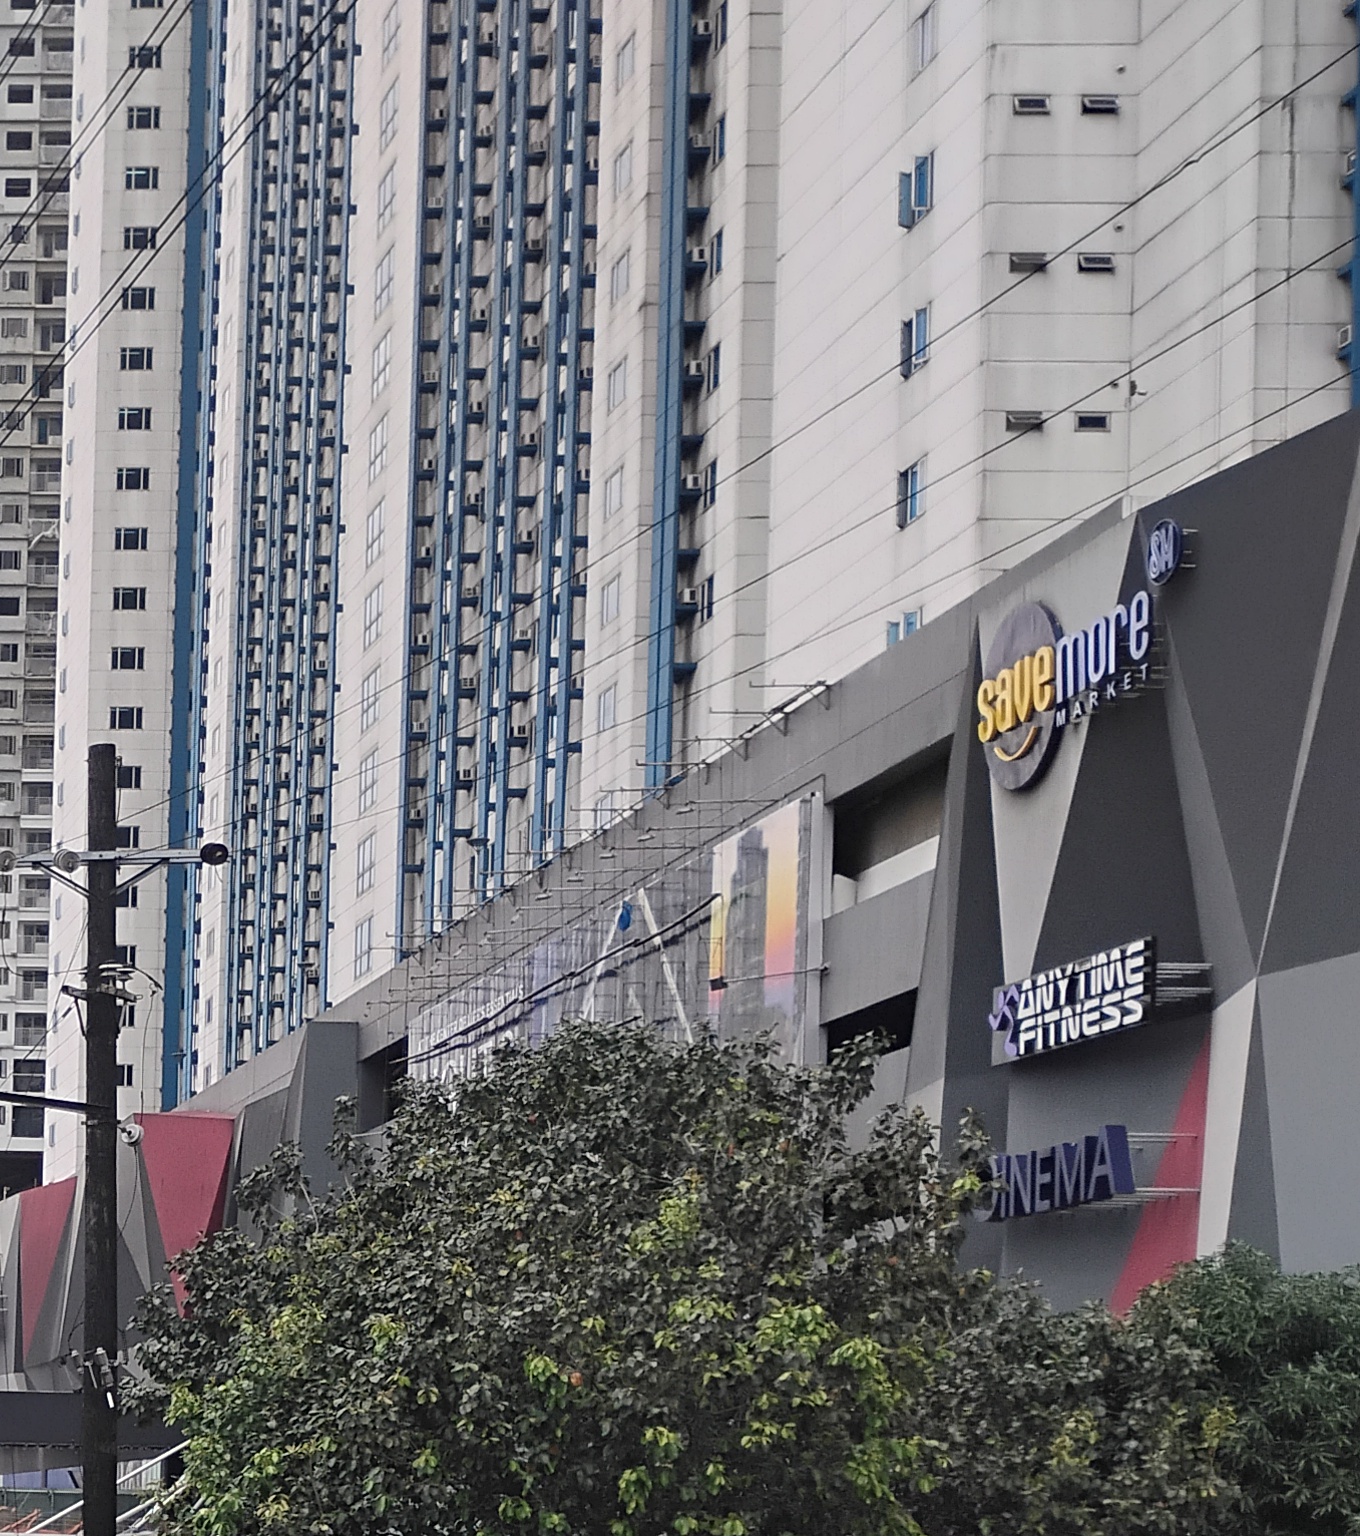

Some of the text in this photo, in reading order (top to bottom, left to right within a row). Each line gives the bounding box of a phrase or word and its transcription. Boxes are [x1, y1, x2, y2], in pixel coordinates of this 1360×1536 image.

[978, 590, 1149, 744] savemore
[1056, 663, 1148, 727] MARKET
[1017, 940, 1145, 1020] ANYTIME
[1019, 985, 1144, 1055] FITNESS
